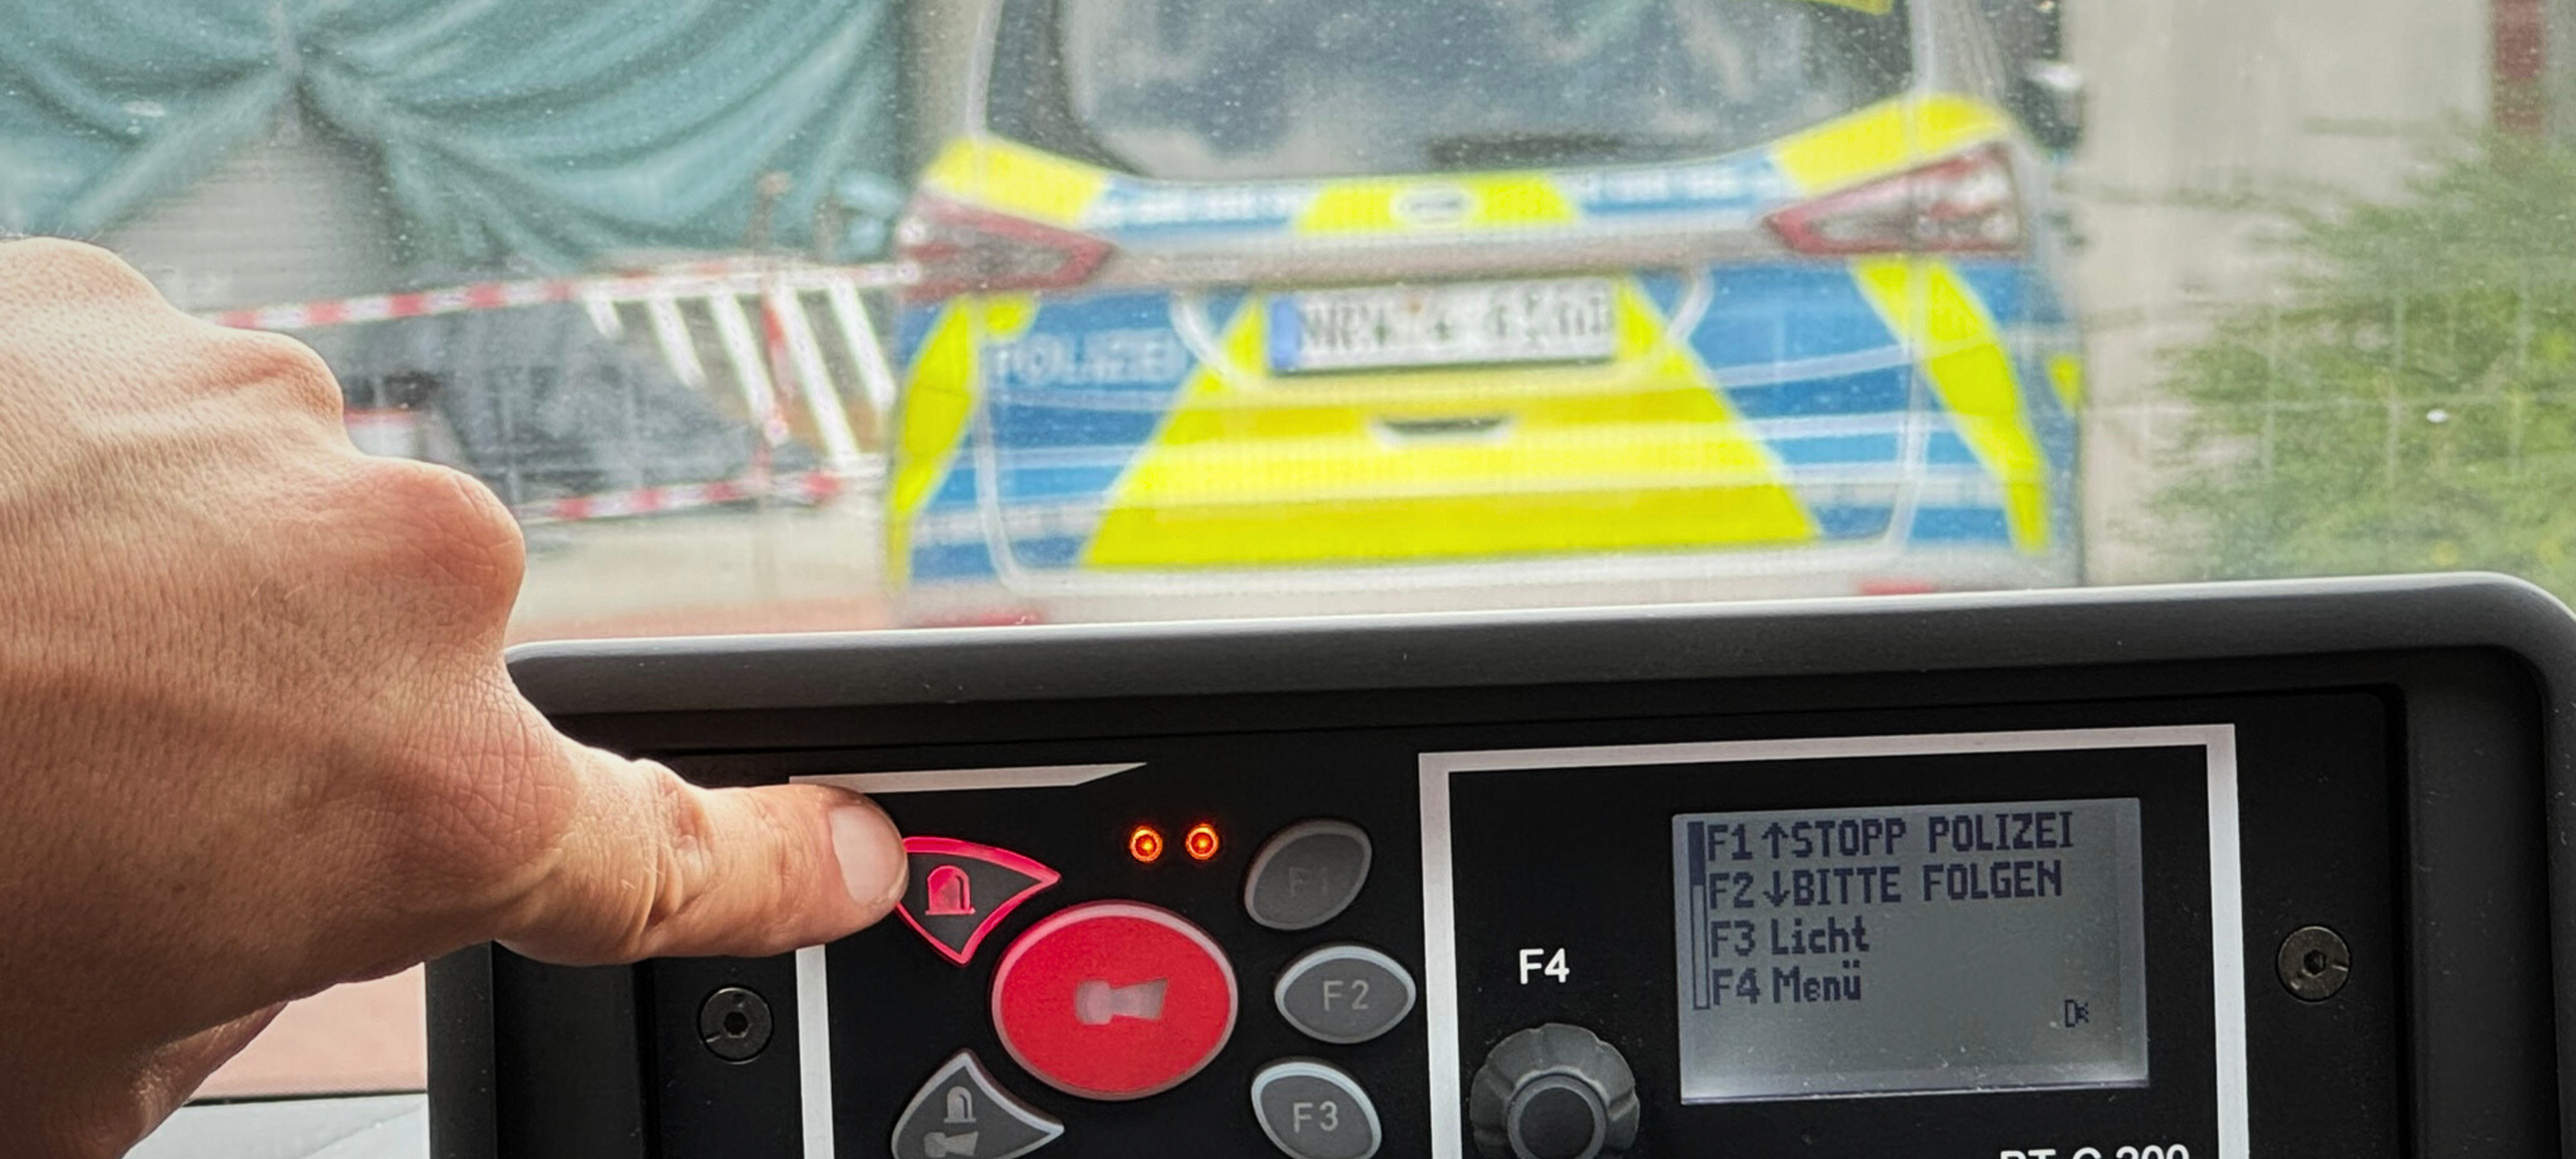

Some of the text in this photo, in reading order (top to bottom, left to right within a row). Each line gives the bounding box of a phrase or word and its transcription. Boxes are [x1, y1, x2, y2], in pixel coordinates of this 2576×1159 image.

[1706, 811, 2074, 861] F1 STOPP POLIZEI
[1708, 860, 2063, 909] F2 BITTE FOLGEN
[1710, 915, 1870, 958] F3 Licht
[1518, 947, 1571, 985] F4
[1712, 960, 1862, 1005] F4 Menü
[1322, 979, 1370, 1012] F2
[1292, 1100, 1340, 1134] F3
